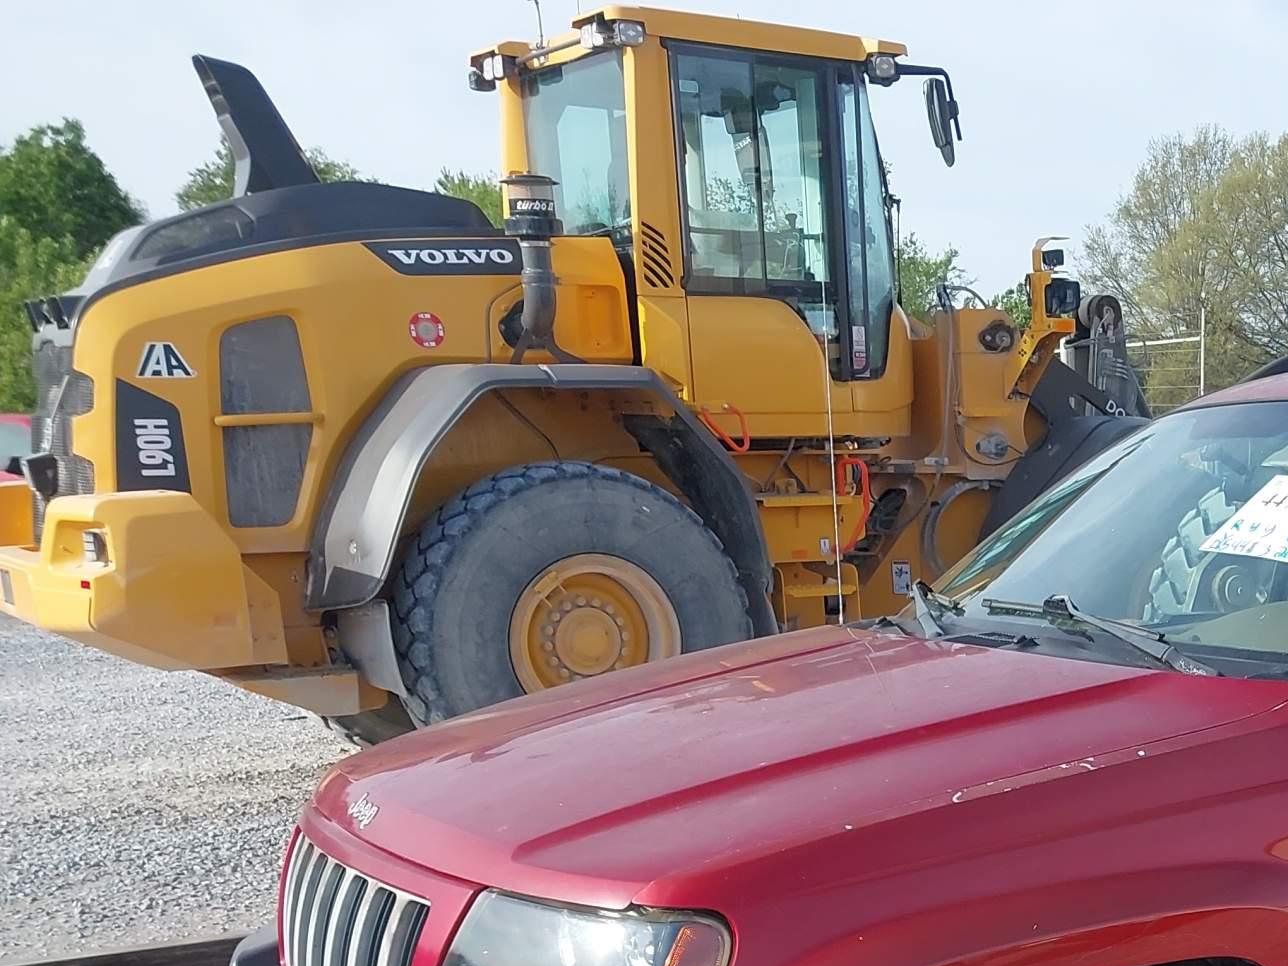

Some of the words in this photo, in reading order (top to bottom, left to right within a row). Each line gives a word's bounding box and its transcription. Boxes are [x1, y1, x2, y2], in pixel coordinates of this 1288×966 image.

[516, 200, 547, 210] turbo
[387, 249, 514, 264] VOLVO
[133, 418, 176, 476] L90H
[347, 792, 379, 830] Jeep
